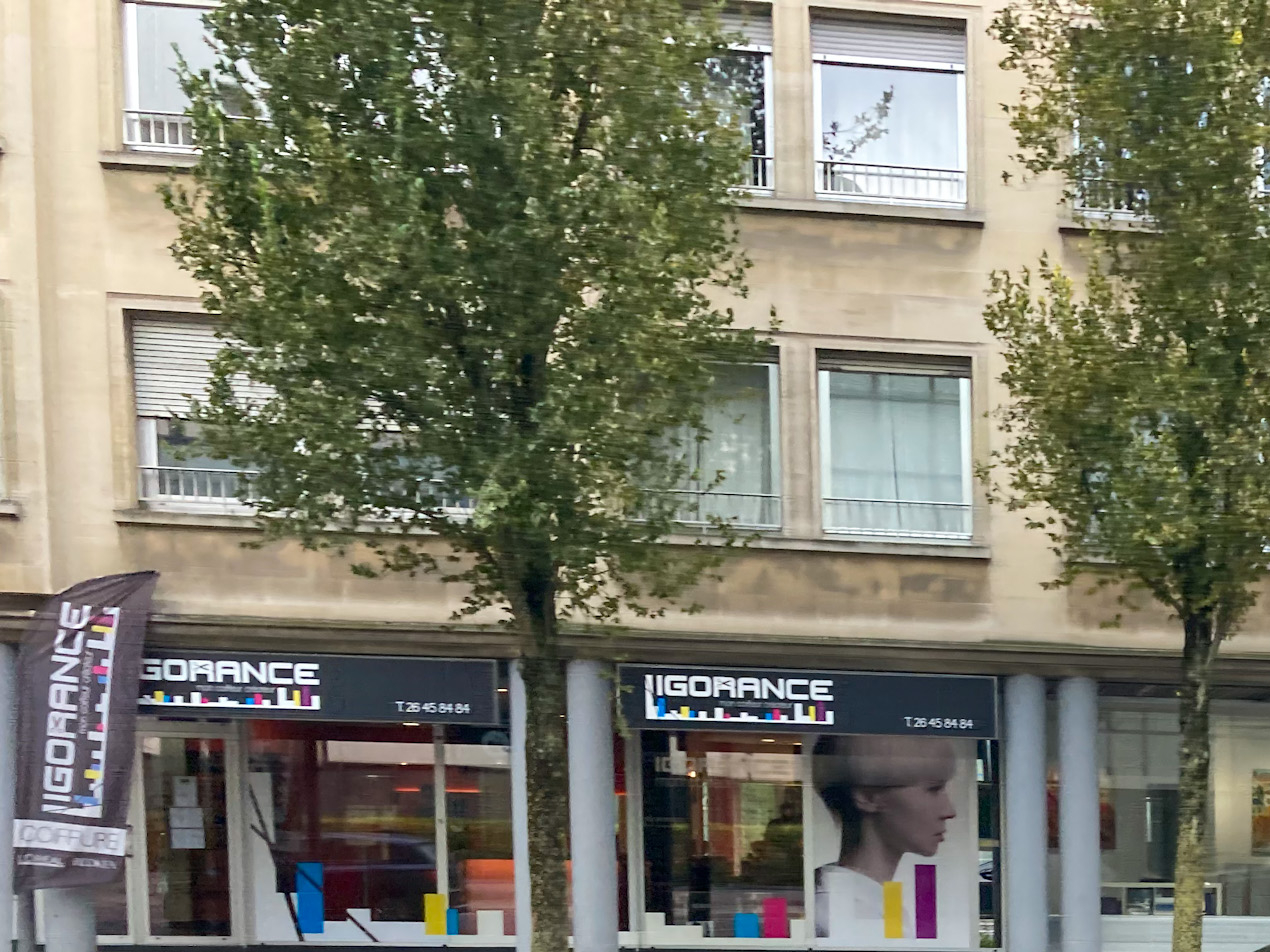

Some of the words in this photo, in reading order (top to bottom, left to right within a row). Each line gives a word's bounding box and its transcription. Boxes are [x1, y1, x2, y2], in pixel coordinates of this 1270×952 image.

[422, 702, 437, 713] 45
[438, 702, 453, 714] 84
[455, 703, 470, 714] 84
[928, 717, 943, 729] 45
[944, 718, 958, 729] 84
[959, 718, 974, 730] 84
